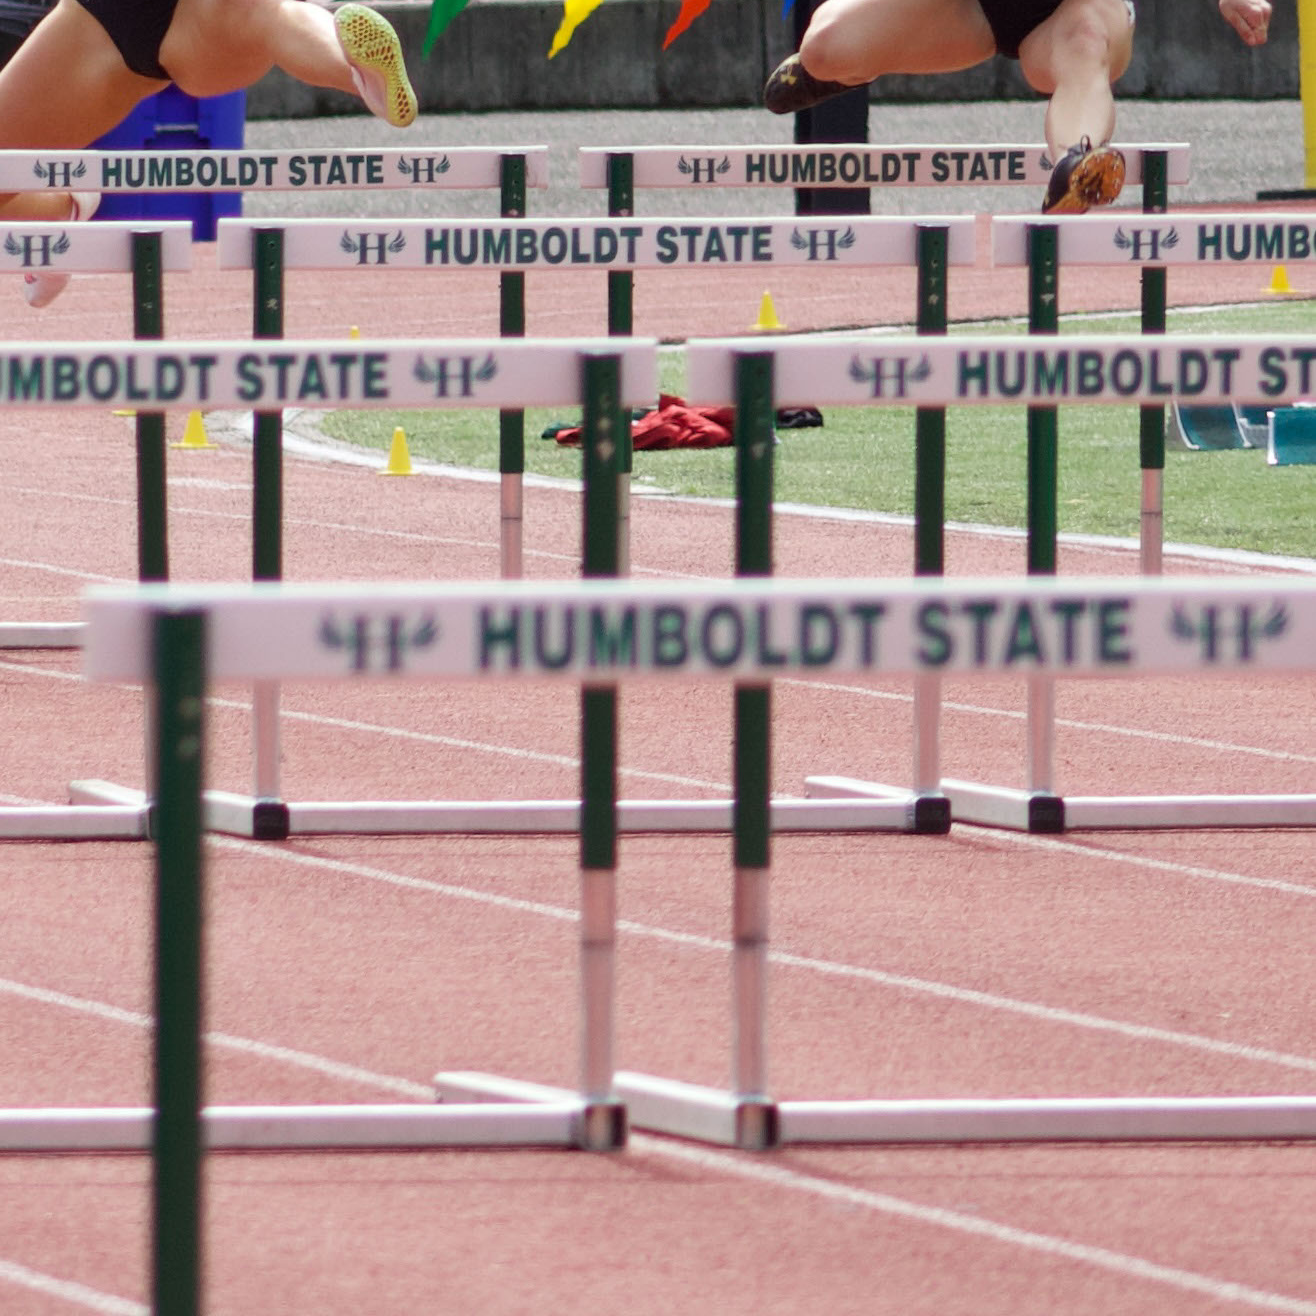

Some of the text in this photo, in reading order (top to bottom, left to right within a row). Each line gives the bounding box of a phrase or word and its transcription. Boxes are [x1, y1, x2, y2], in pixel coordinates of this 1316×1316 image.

[101, 156, 279, 188] HUMBOLDT
[288, 154, 384, 187] STATE
[746, 152, 921, 184] HUMBOLDT
[931, 150, 1026, 183] STATE
[425, 226, 643, 265] HUMBOLDT
[655, 225, 773, 264] STATE
[1198, 224, 1316, 261] HUMB
[236, 353, 389, 402] STATE
[958, 348, 1241, 398] HUMBOLDT
[479, 602, 886, 671] HUMBOLDT
[916, 598, 1132, 669] STATE
